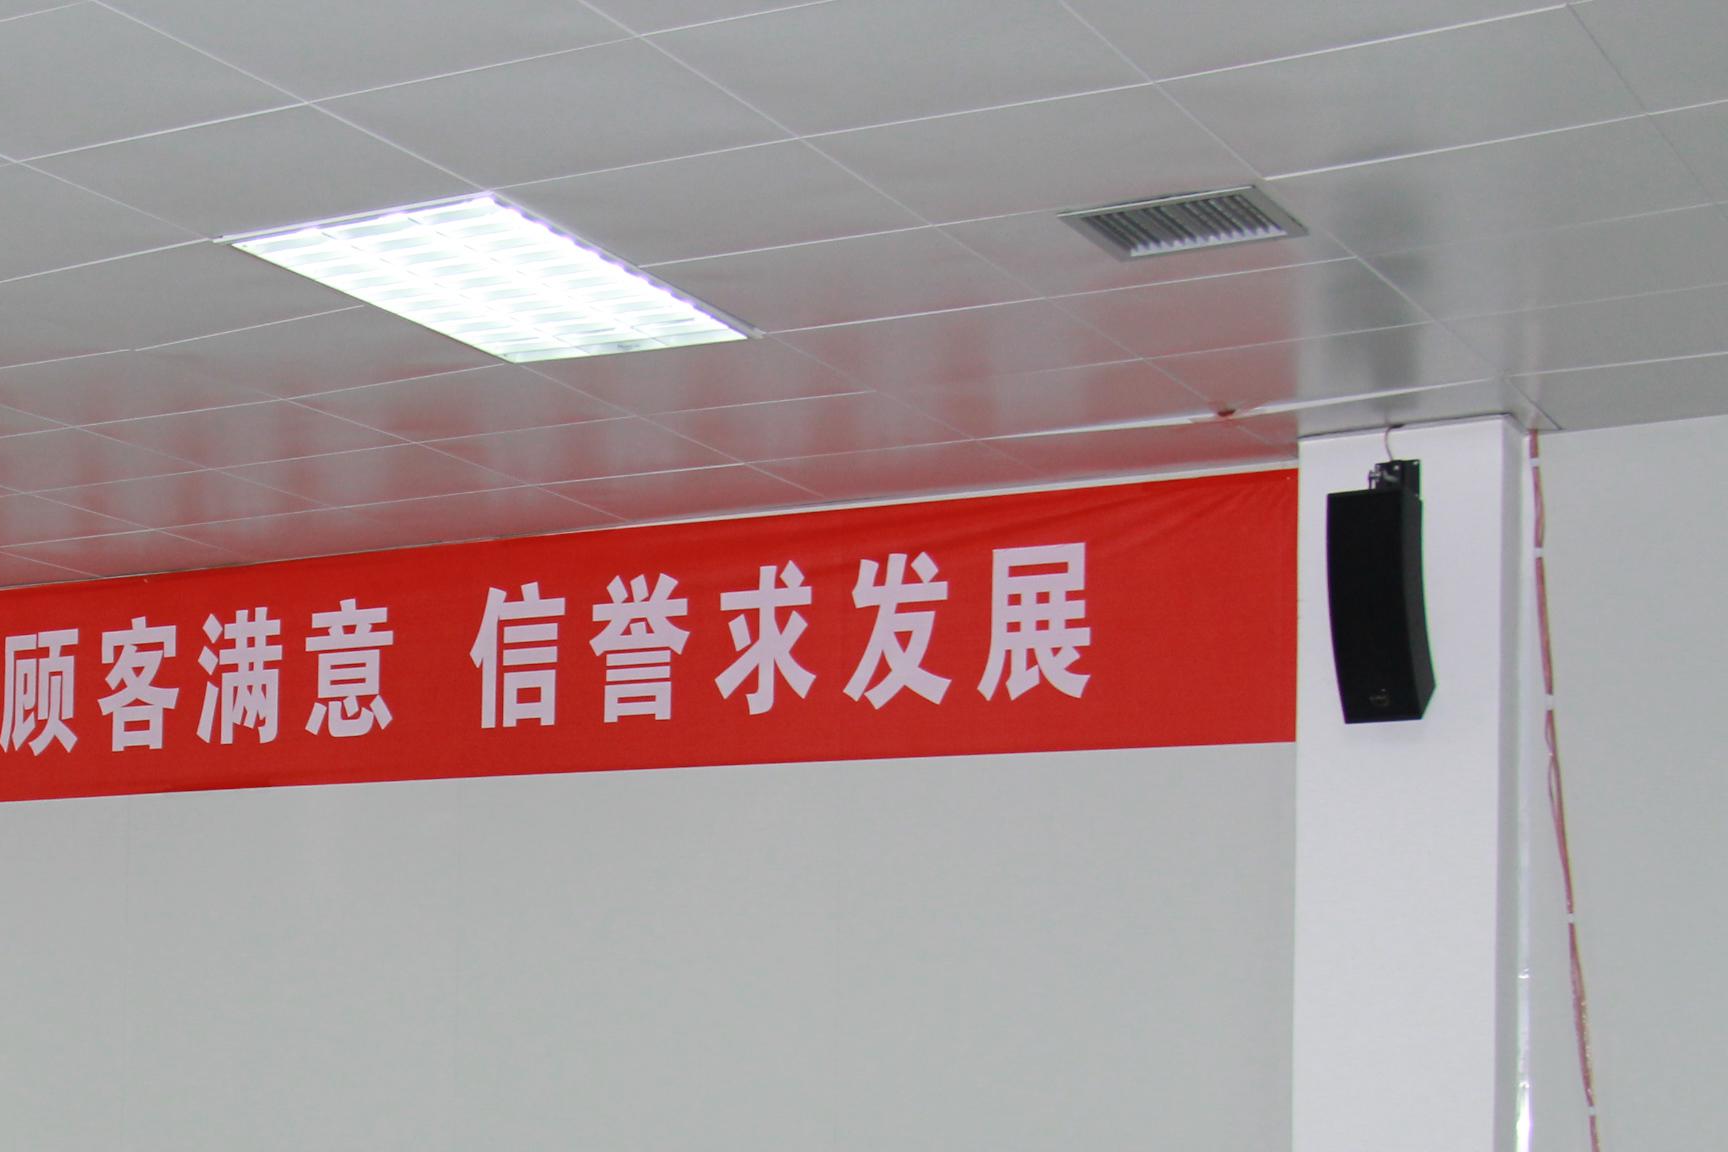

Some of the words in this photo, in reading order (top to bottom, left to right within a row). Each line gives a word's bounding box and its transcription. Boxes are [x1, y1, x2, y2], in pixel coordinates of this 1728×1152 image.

[0, 598, 395, 757] 顾客满意
[470, 542, 1093, 730] 信誉求发展
